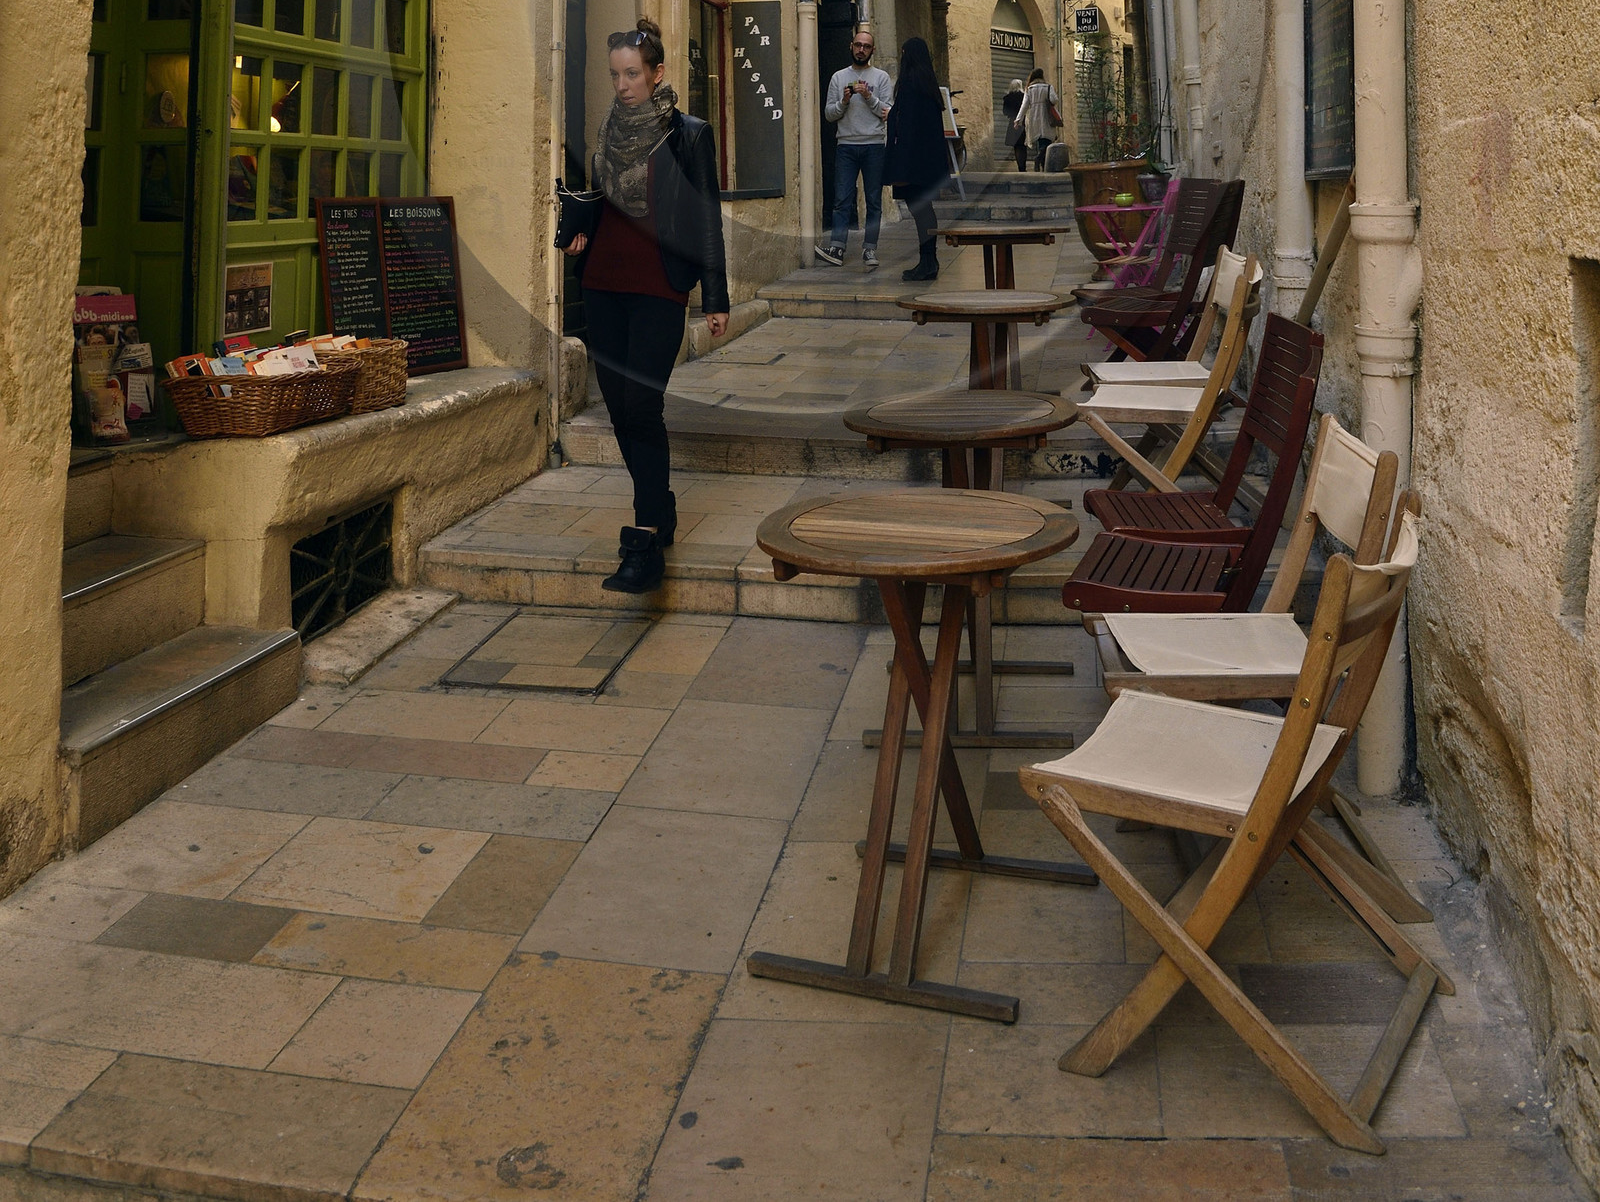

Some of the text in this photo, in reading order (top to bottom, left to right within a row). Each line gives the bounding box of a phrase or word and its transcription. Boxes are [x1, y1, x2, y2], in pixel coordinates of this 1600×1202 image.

[1076, 9, 1096, 17] VENT
[1081, 17, 1092, 25] DU
[744, 16, 771, 46] PAR
[1077, 24, 1097, 32] NORD
[991, 31, 1004, 45] ENT
[1004, 33, 1013, 47] DU
[733, 47, 783, 120] HASARD
[330, 209, 341, 219] LES
[389, 208, 404, 218] LES
